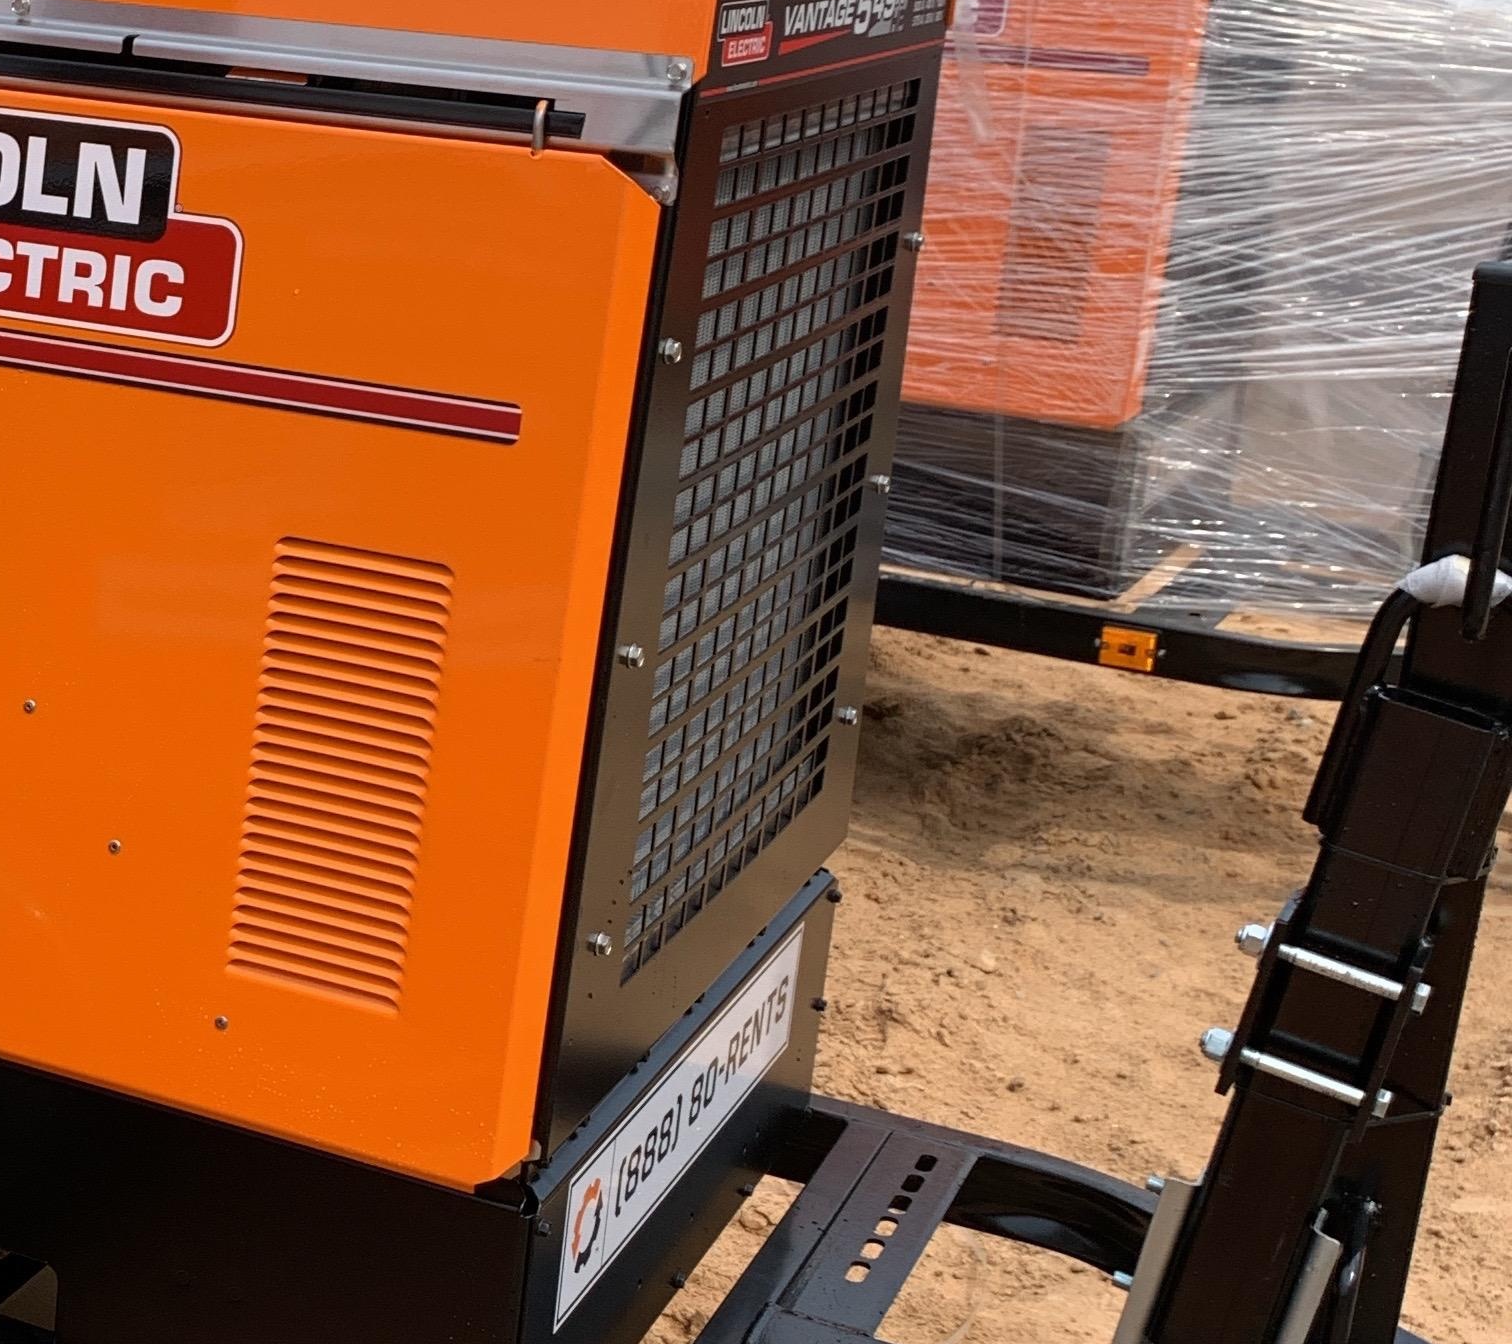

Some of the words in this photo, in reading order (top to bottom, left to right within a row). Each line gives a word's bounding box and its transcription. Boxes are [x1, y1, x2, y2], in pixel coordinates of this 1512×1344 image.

[721, 5, 766, 34] LINCOLN
[727, 36, 766, 58] ELECTRIC
[614, 1093, 683, 1217] (888)
[688, 975, 789, 1128] 80-RENTS
